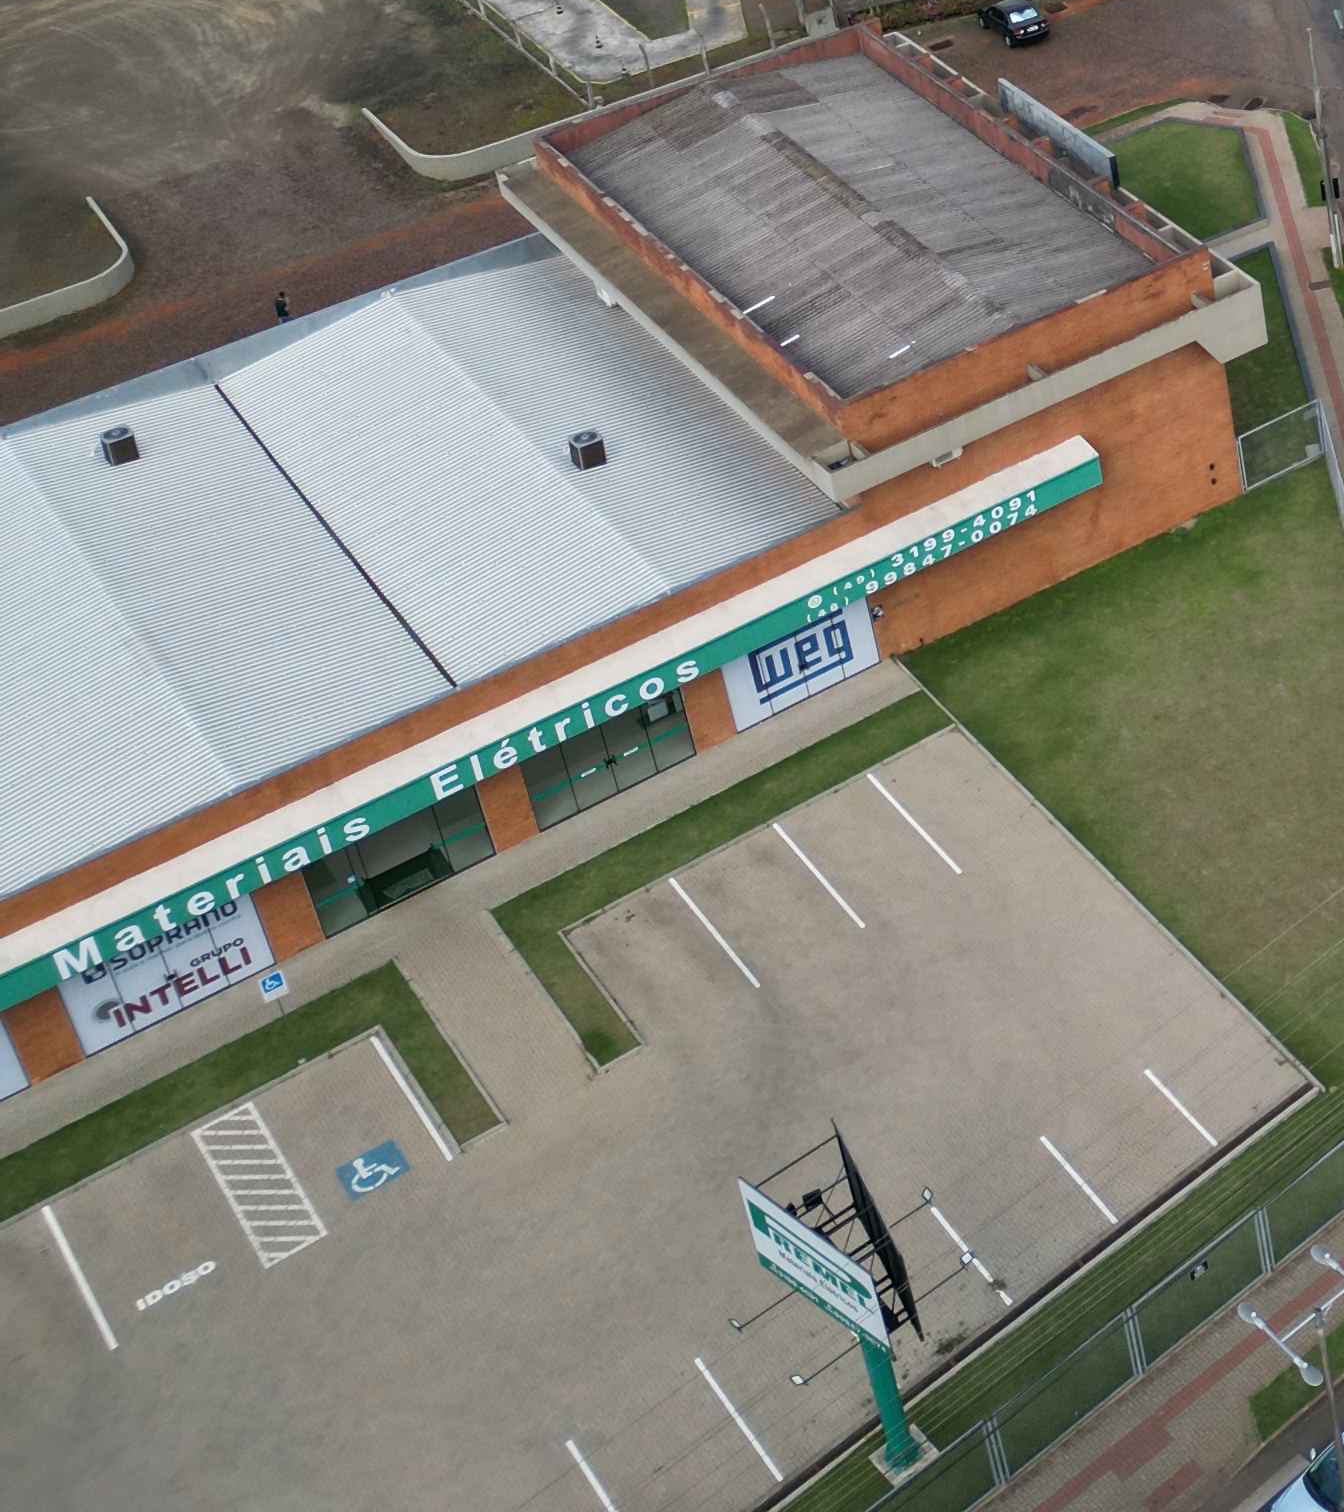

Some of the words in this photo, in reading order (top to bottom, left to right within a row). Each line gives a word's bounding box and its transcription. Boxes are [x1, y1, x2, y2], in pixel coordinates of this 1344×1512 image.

[865, 503, 1038, 595] 99847-0074
[890, 489, 1037, 569] 3199-4091
[52, 815, 371, 981] Materiais
[429, 659, 700, 801] Elétricos
[113, 901, 239, 972] SOPRANO
[190, 937, 244, 968] GRUPO
[112, 946, 252, 1029] INTELLI
[136, 1260, 216, 1311] IDOSO
